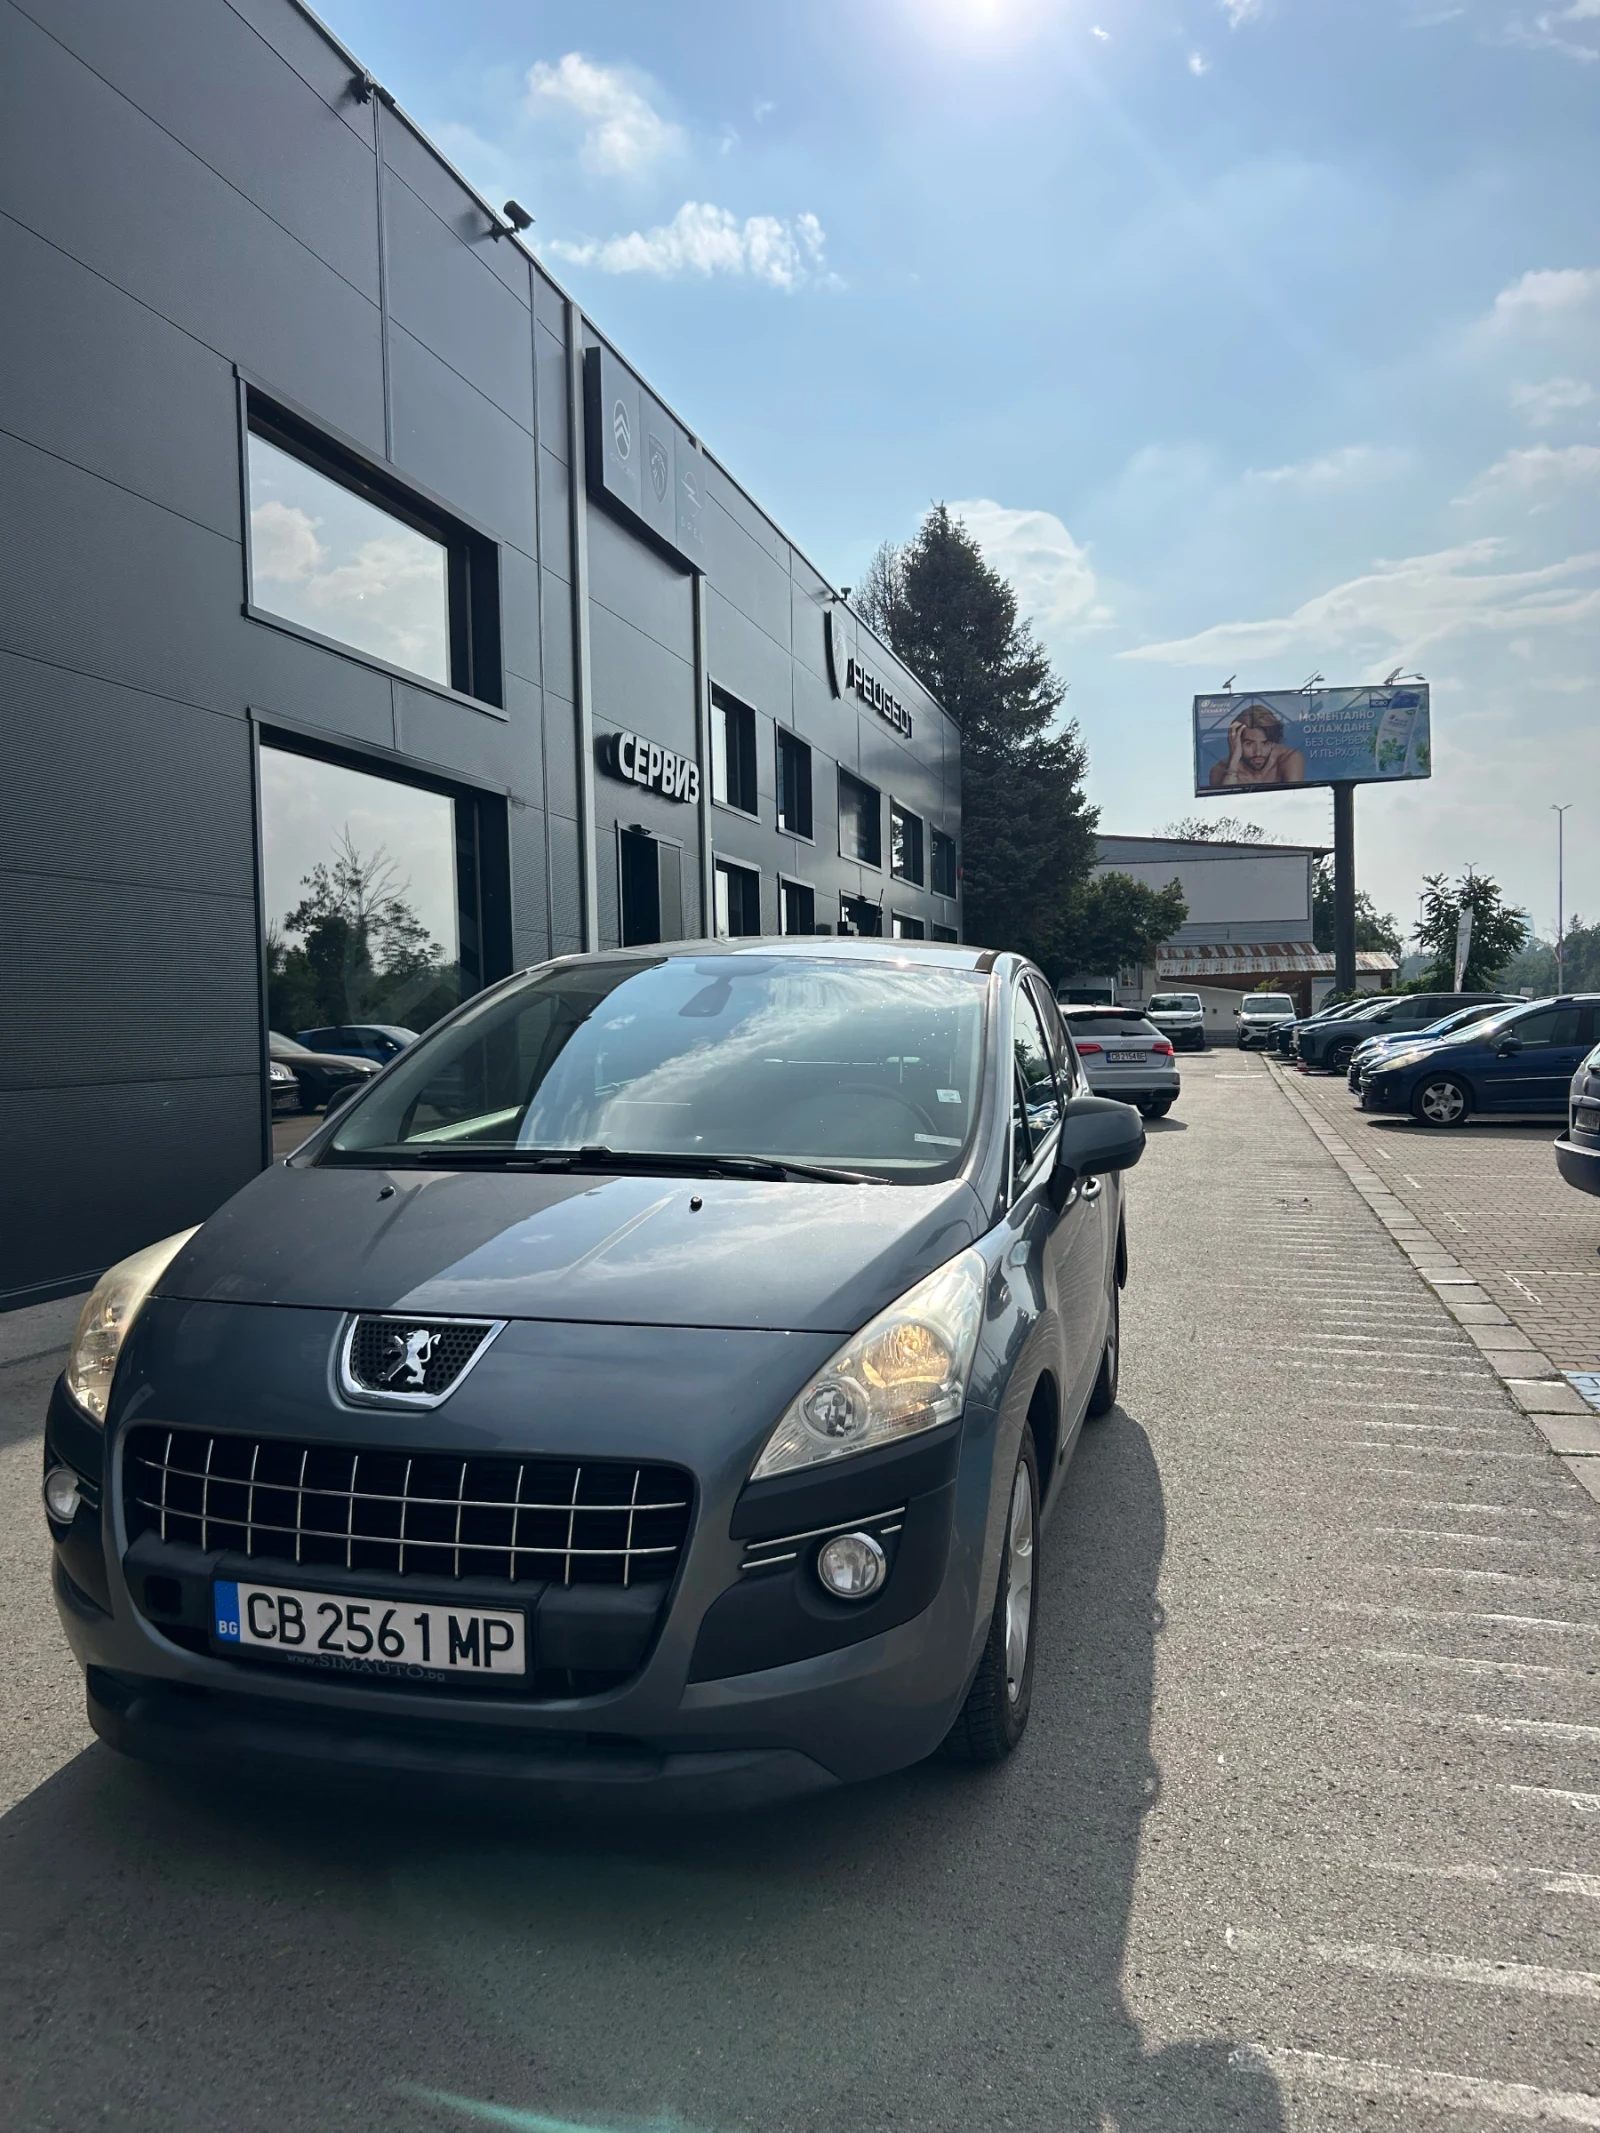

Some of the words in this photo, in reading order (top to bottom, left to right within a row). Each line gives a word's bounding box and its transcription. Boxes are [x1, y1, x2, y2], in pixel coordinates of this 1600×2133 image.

[852, 658, 915, 739] PEUGEOT
[1299, 710, 1375, 722] МОМЕНТАЛНО
[1303, 722, 1372, 733] ОХЛАЖДАНЕ
[1305, 737, 1324, 746] БЕЗ
[1325, 735, 1369, 746] СЪРБЕЖ
[1309, 749, 1317, 758] И
[616, 731, 700, 805] СЕРВИЗ
[218, 1620, 238, 1635] BG
[317, 1602, 431, 1662] 2561
[286, 1653, 445, 1682] www.SIMAUTO.bg
